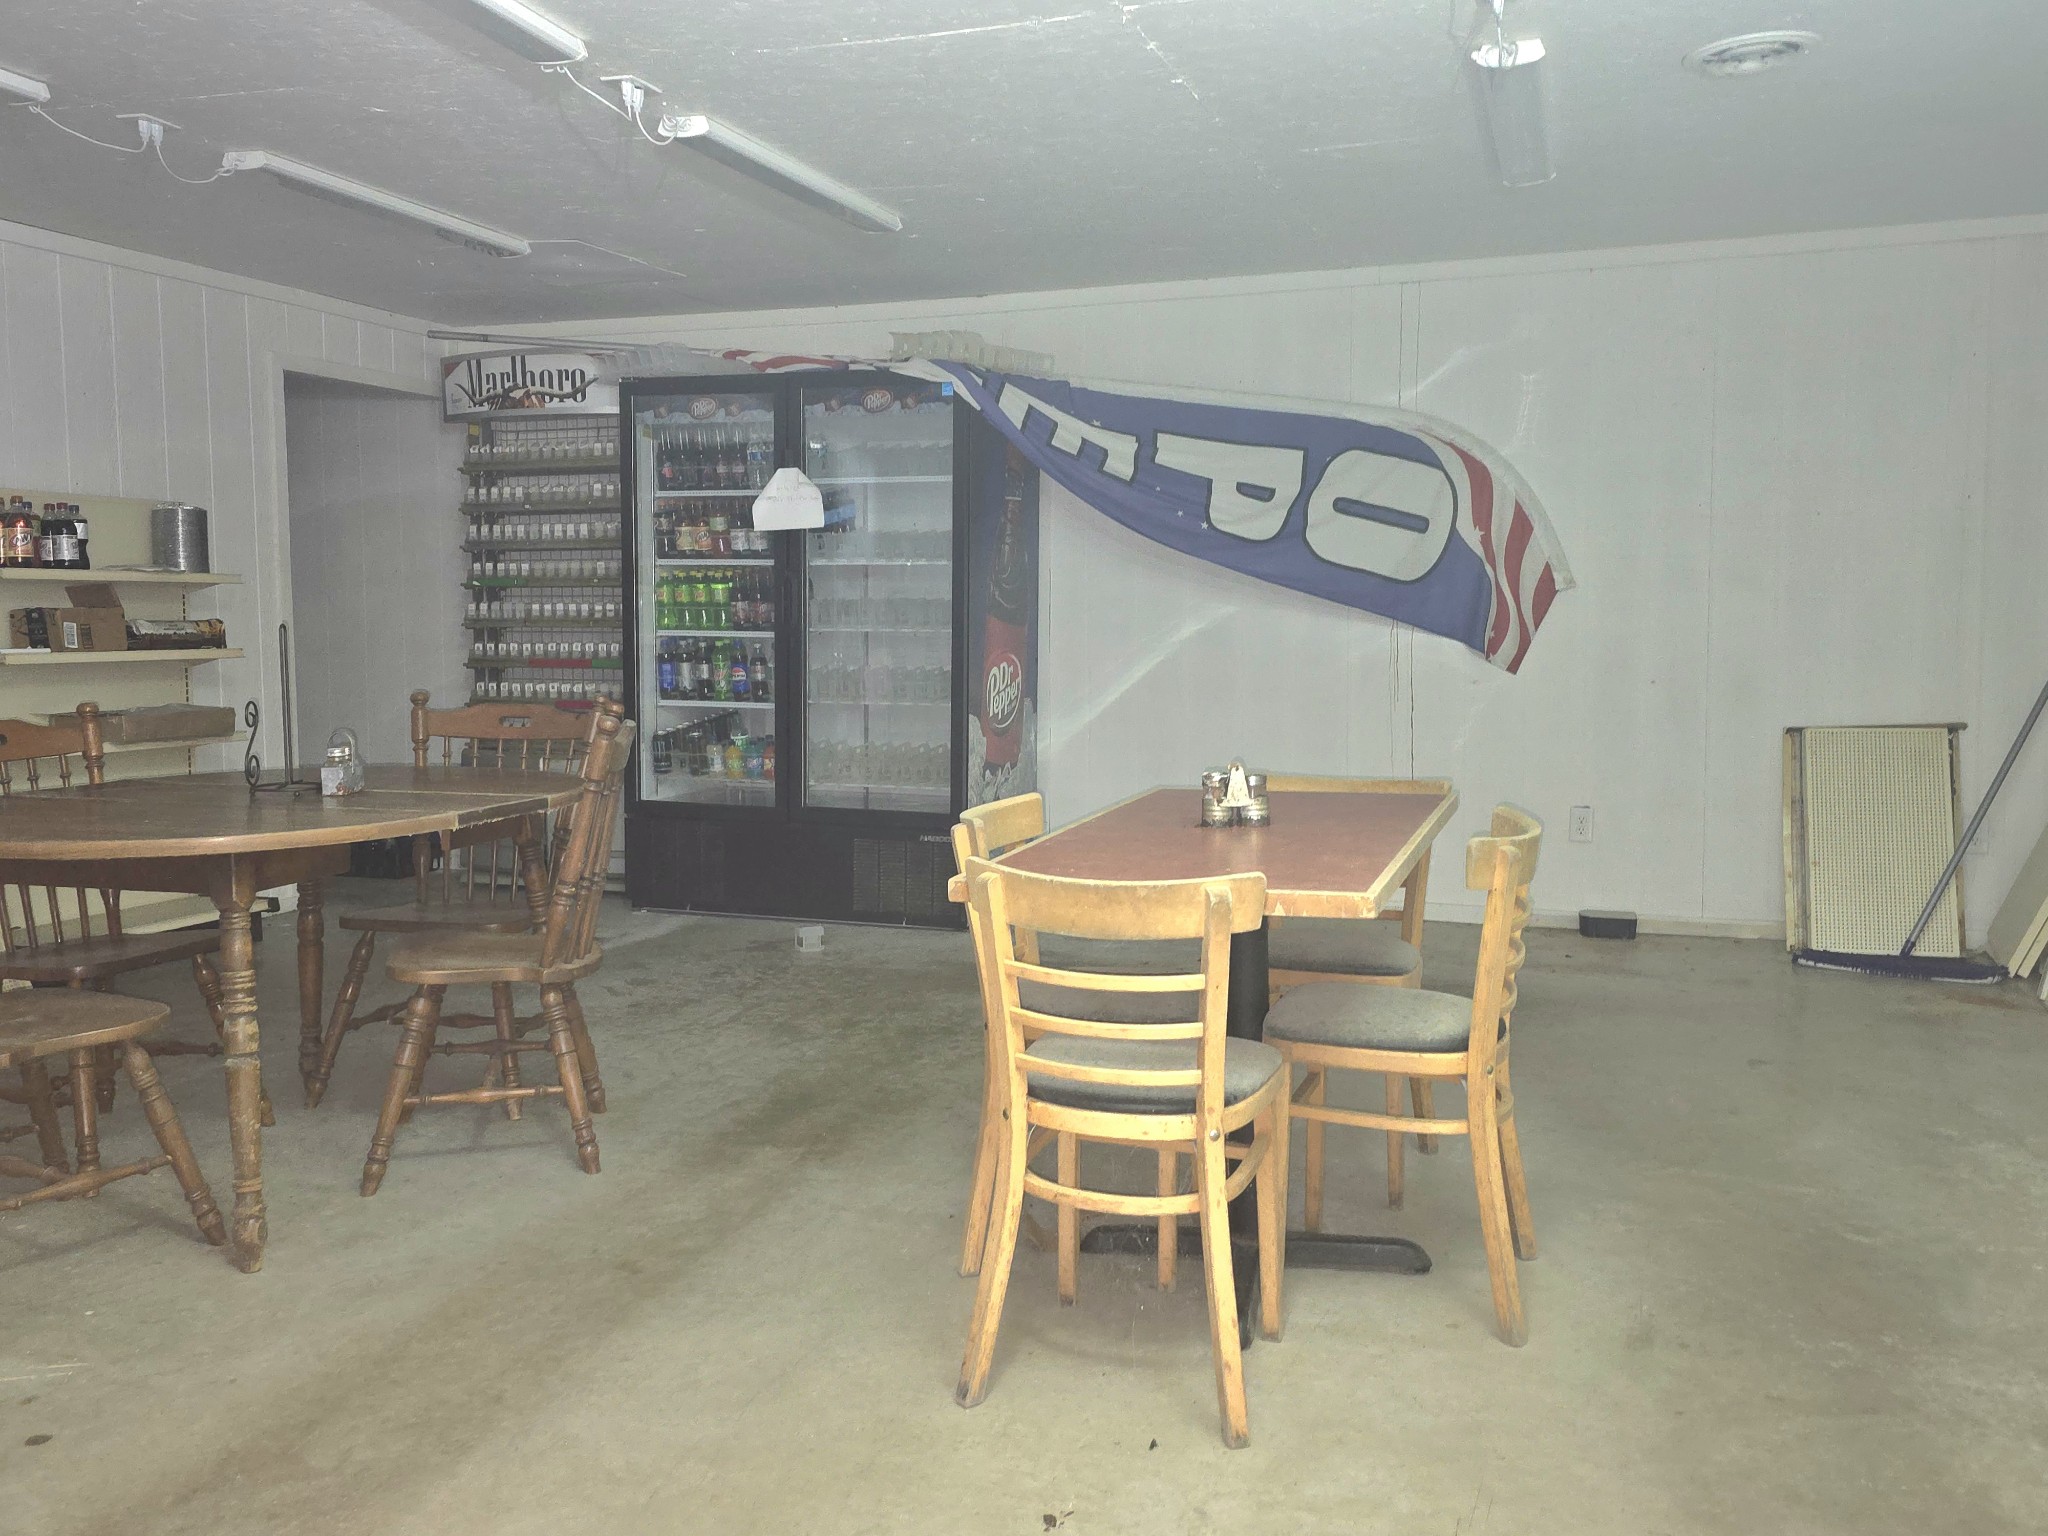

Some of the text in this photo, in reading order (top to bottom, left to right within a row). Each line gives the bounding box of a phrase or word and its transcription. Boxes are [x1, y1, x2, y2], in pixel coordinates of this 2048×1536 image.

[467, 355, 587, 408] Marlboro
[988, 666, 1018, 720] Pepper
[1000, 661, 1014, 691] Dr
